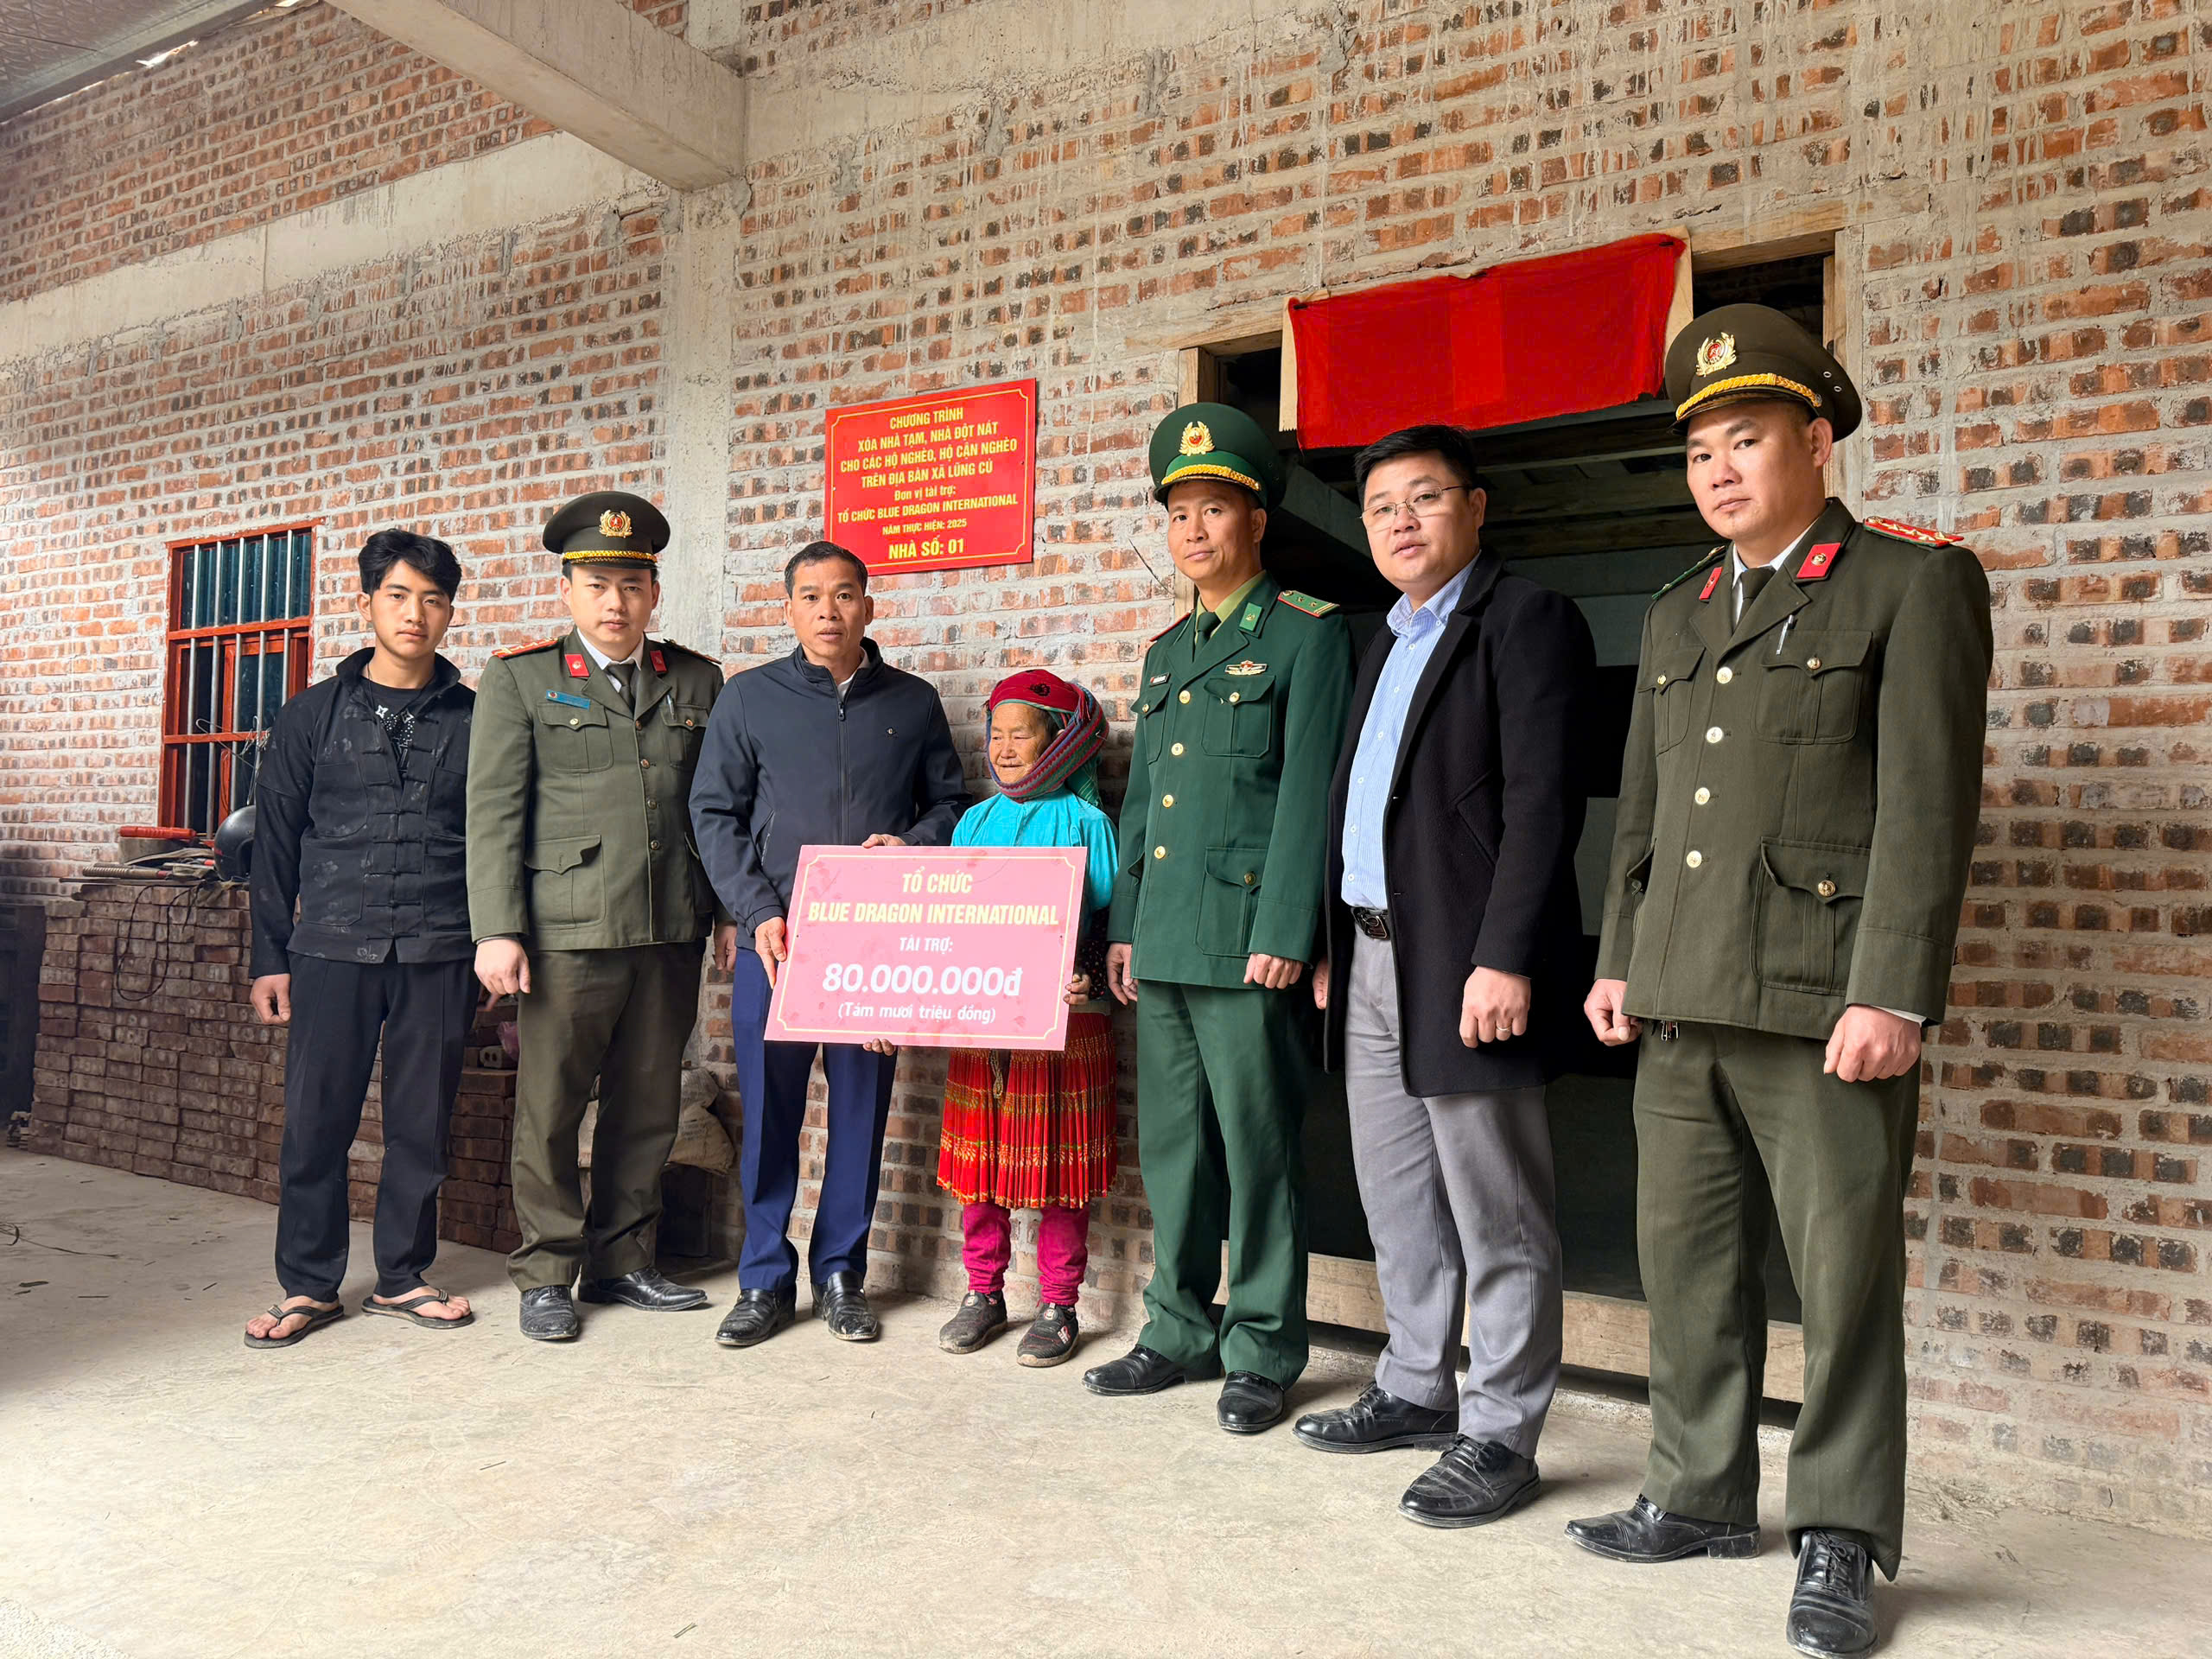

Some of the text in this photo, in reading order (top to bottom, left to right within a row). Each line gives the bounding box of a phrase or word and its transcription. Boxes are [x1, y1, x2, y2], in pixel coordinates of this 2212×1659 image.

[890, 407, 964, 429] CHƯƠNG TRÌNH
[858, 419, 998, 453] XÓA NHÀ TẠM, NHÀ ĐỘT NÁT
[840, 436, 1018, 473] CHO CÁC HỘ NGHÈO, HỘ CẬN NGHÈO
[861, 472, 886, 488] TRÊN
[888, 471, 906, 487] ĐỊA
[907, 467, 929, 483] BÀN
[931, 464, 945, 480] XÃ
[948, 461, 976, 478] LŨNG
[894, 485, 956, 501] Đơn vị tài trợ:
[851, 507, 875, 522] CHỨC
[877, 505, 899, 519] BLUE
[902, 501, 940, 517] DRAGON
[942, 493, 1018, 512] INTERNATIONAL
[882, 518, 967, 535] NĂM THỰC HIỆN: 2025
[888, 534, 964, 560] NHÀ SỐ: 01
[927, 869, 973, 893] CHỨC
[808, 902, 1058, 925] BLUE DRAGON INTERNATIONAL
[899, 934, 954, 955] TÀI TRỢ:
[822, 963, 1023, 997] 80.000.000đ
[837, 1001, 996, 1025] (Tám mươi triệu đồng)
